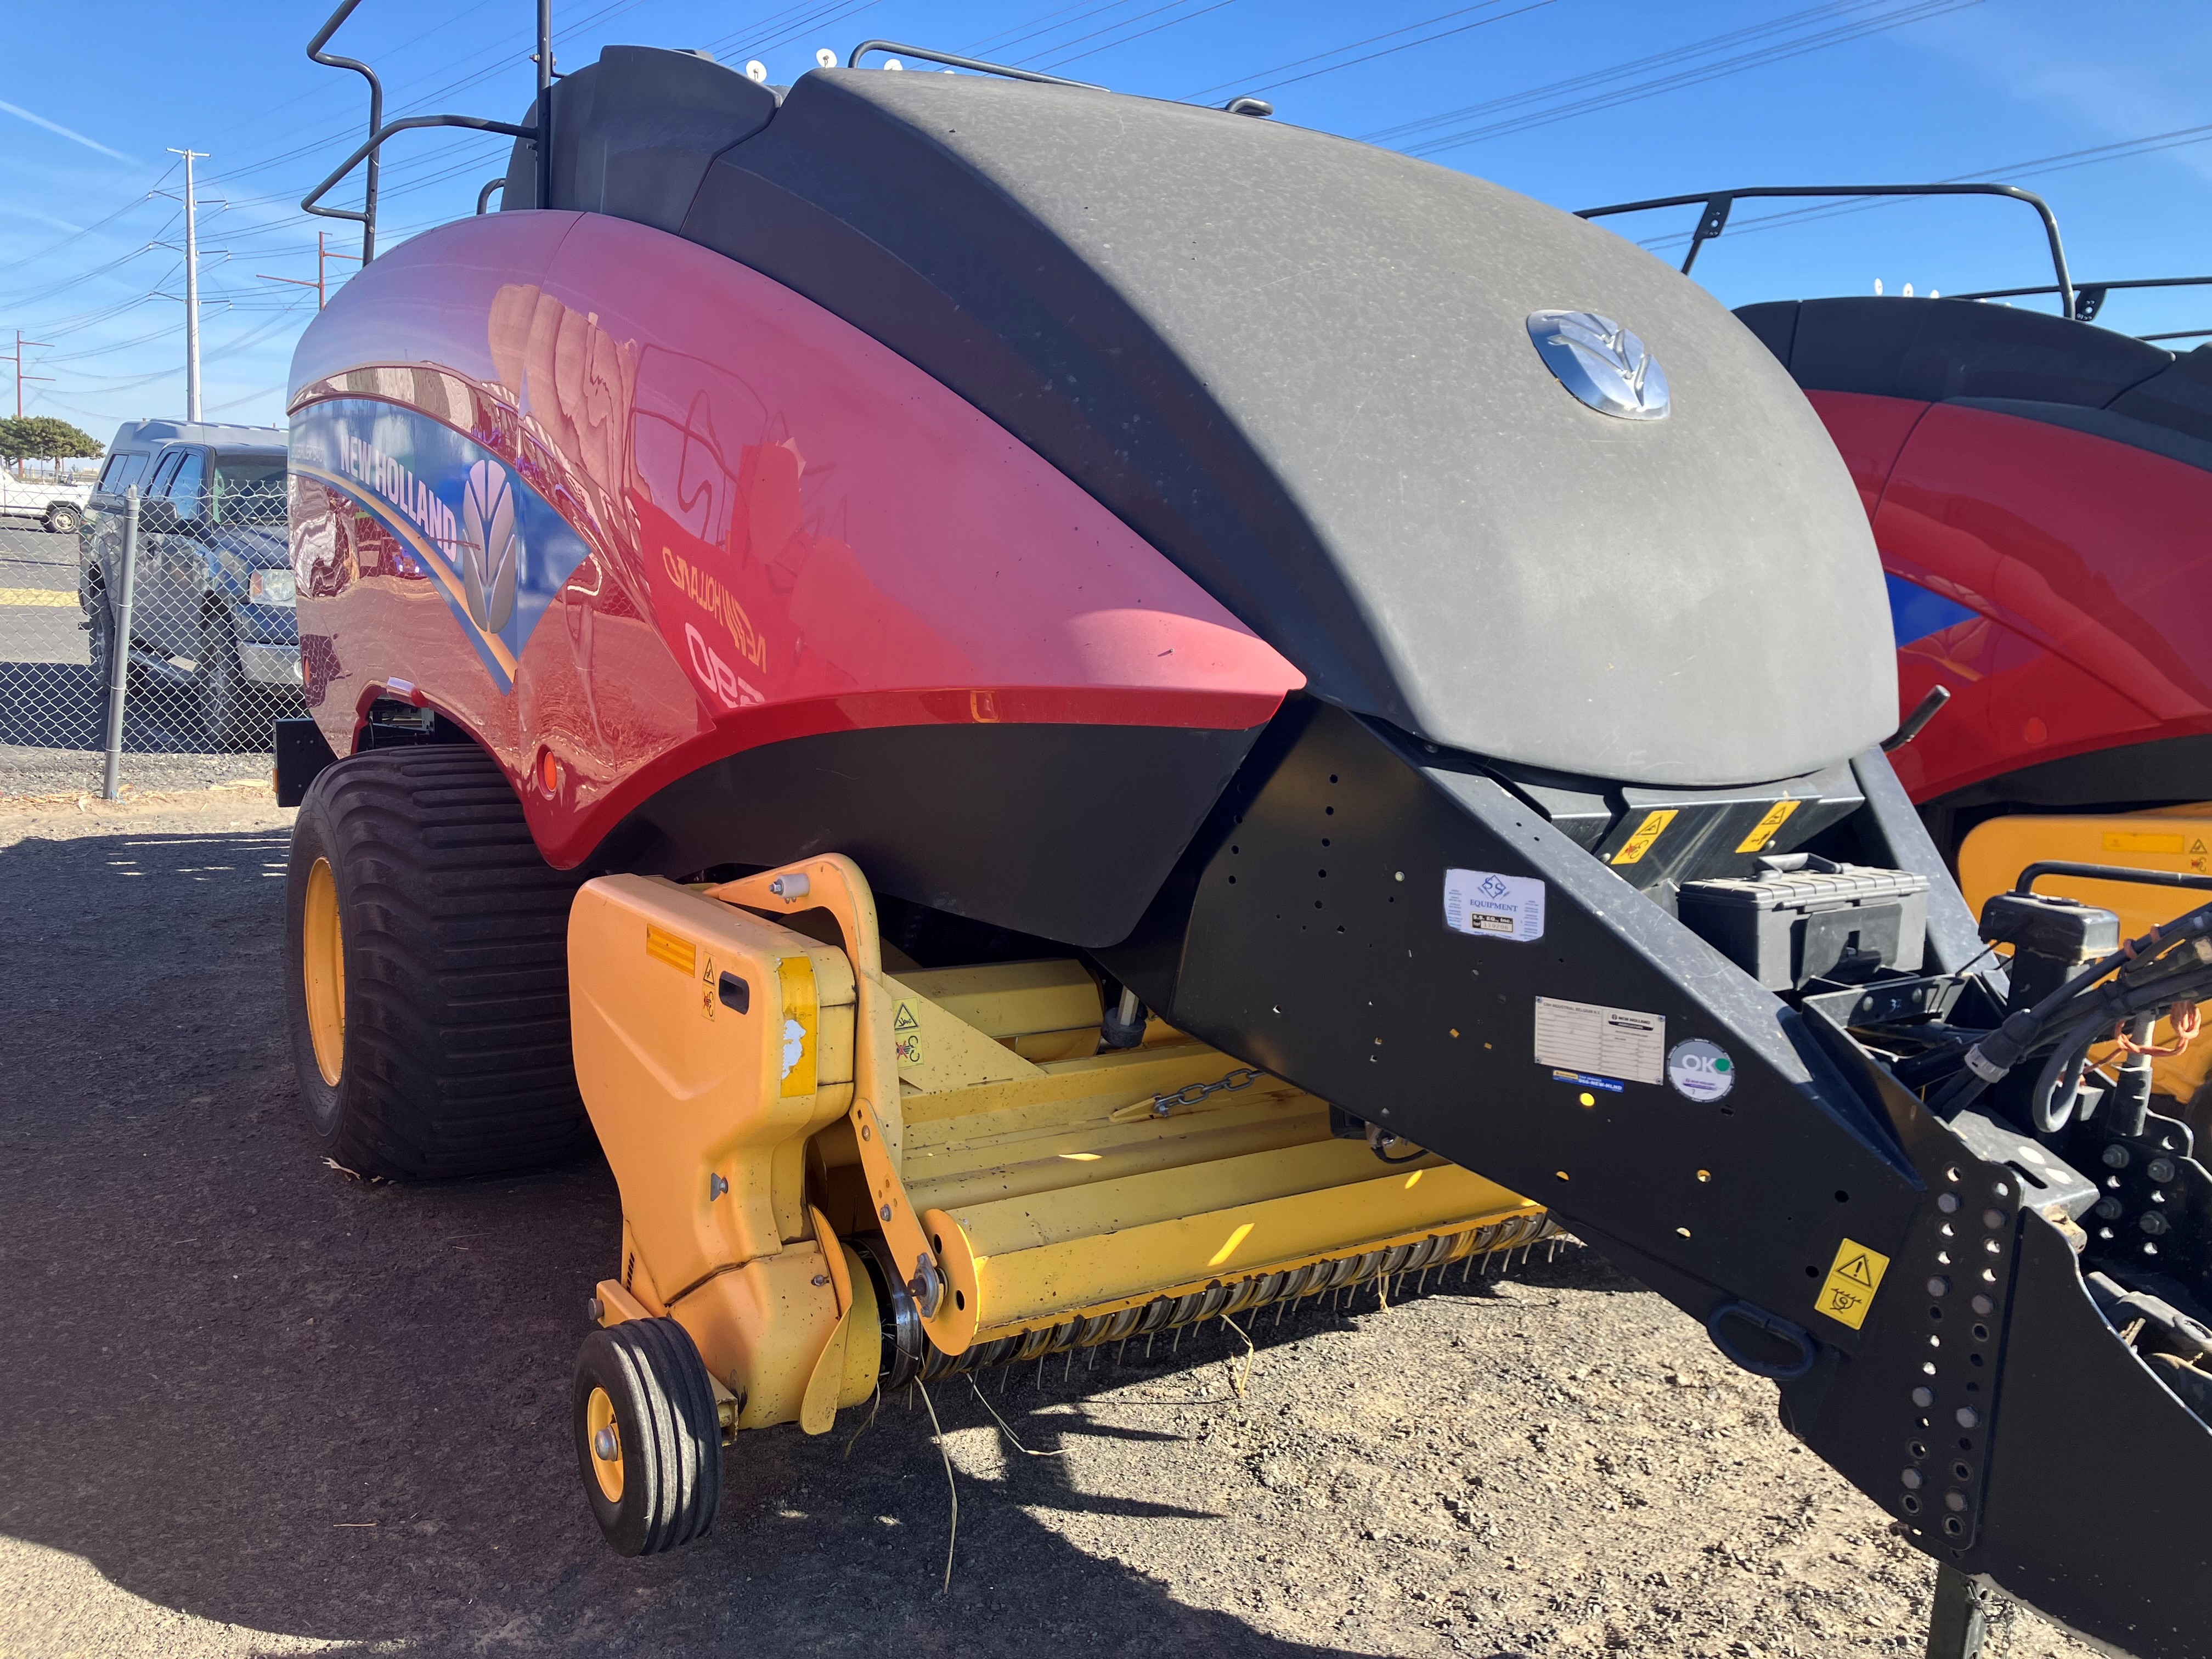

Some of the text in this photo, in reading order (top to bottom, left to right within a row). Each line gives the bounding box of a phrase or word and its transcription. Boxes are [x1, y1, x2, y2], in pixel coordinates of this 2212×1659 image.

[341, 433, 457, 563] NEW HOLLAND
[1470, 899, 1519, 912] EQUIPMENT
[1682, 1054, 1718, 1075] OK
